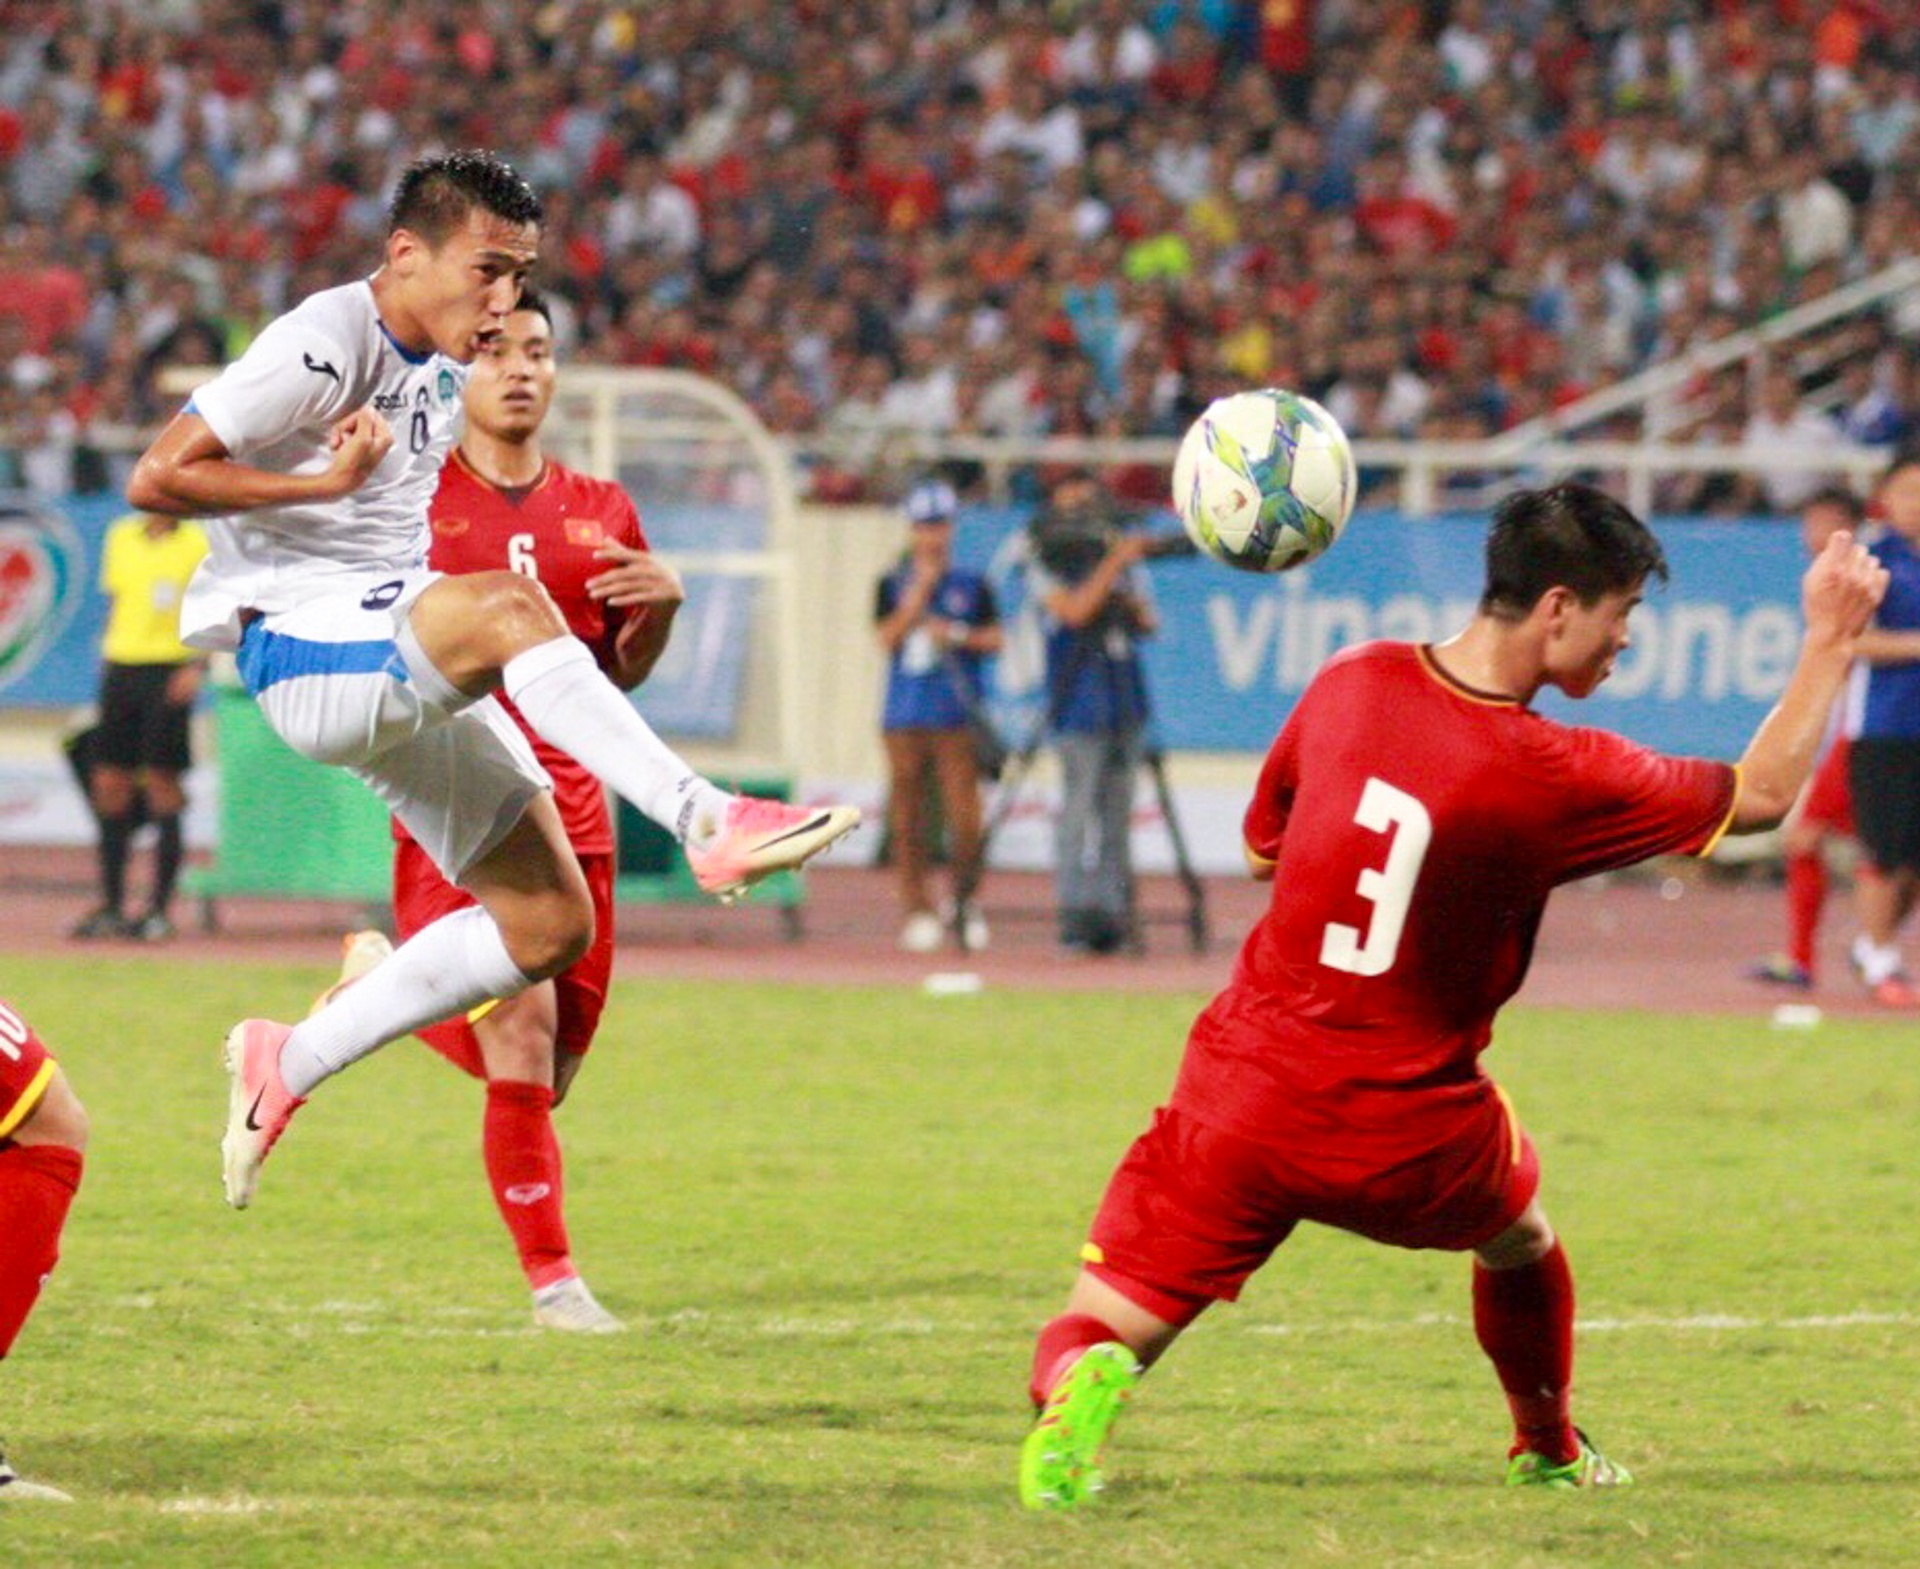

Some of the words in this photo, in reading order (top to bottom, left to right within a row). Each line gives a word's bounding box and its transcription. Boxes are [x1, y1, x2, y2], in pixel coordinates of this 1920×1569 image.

[508, 532, 539, 581] 6
[1203, 568, 1798, 698] vinaone
[1318, 776, 1433, 977] 3
